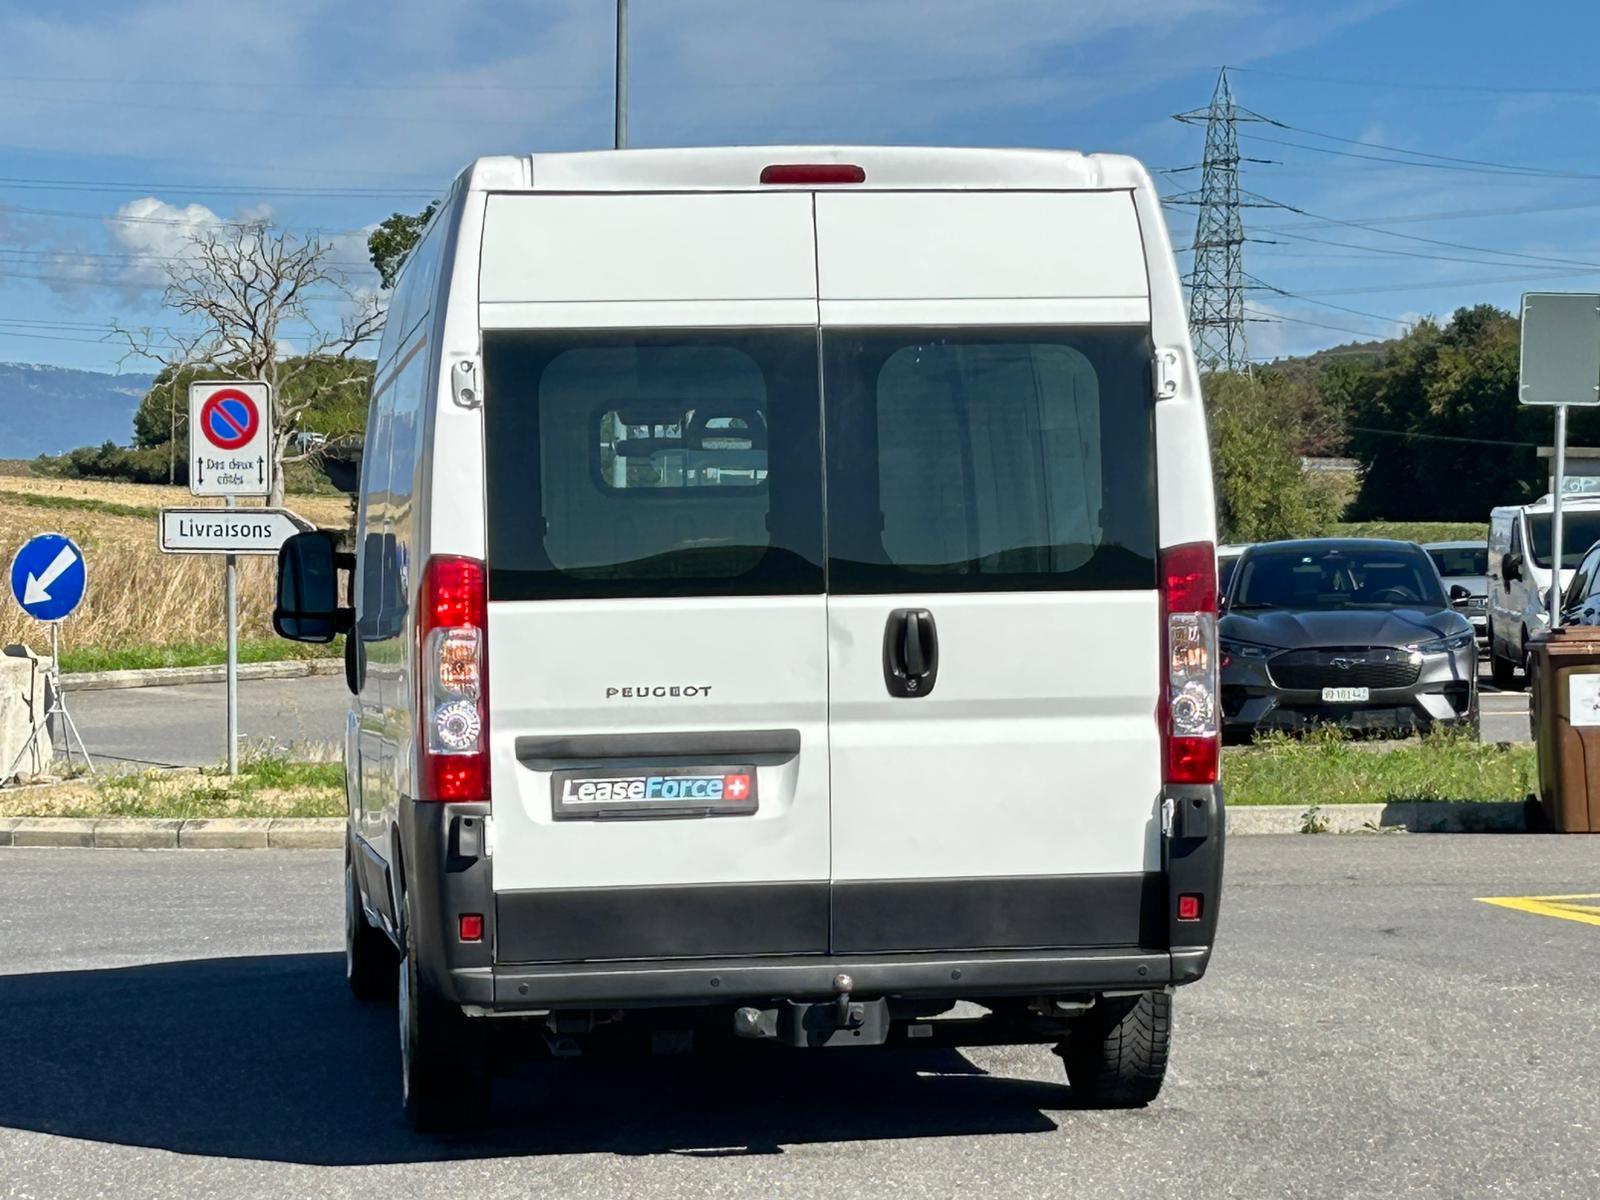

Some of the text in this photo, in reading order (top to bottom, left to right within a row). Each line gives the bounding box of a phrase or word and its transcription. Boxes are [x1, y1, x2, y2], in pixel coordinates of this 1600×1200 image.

[179, 519, 272, 538] Livraisons
[606, 685, 712, 698] PEUGEOT
[562, 776, 723, 804] LeaseForce
